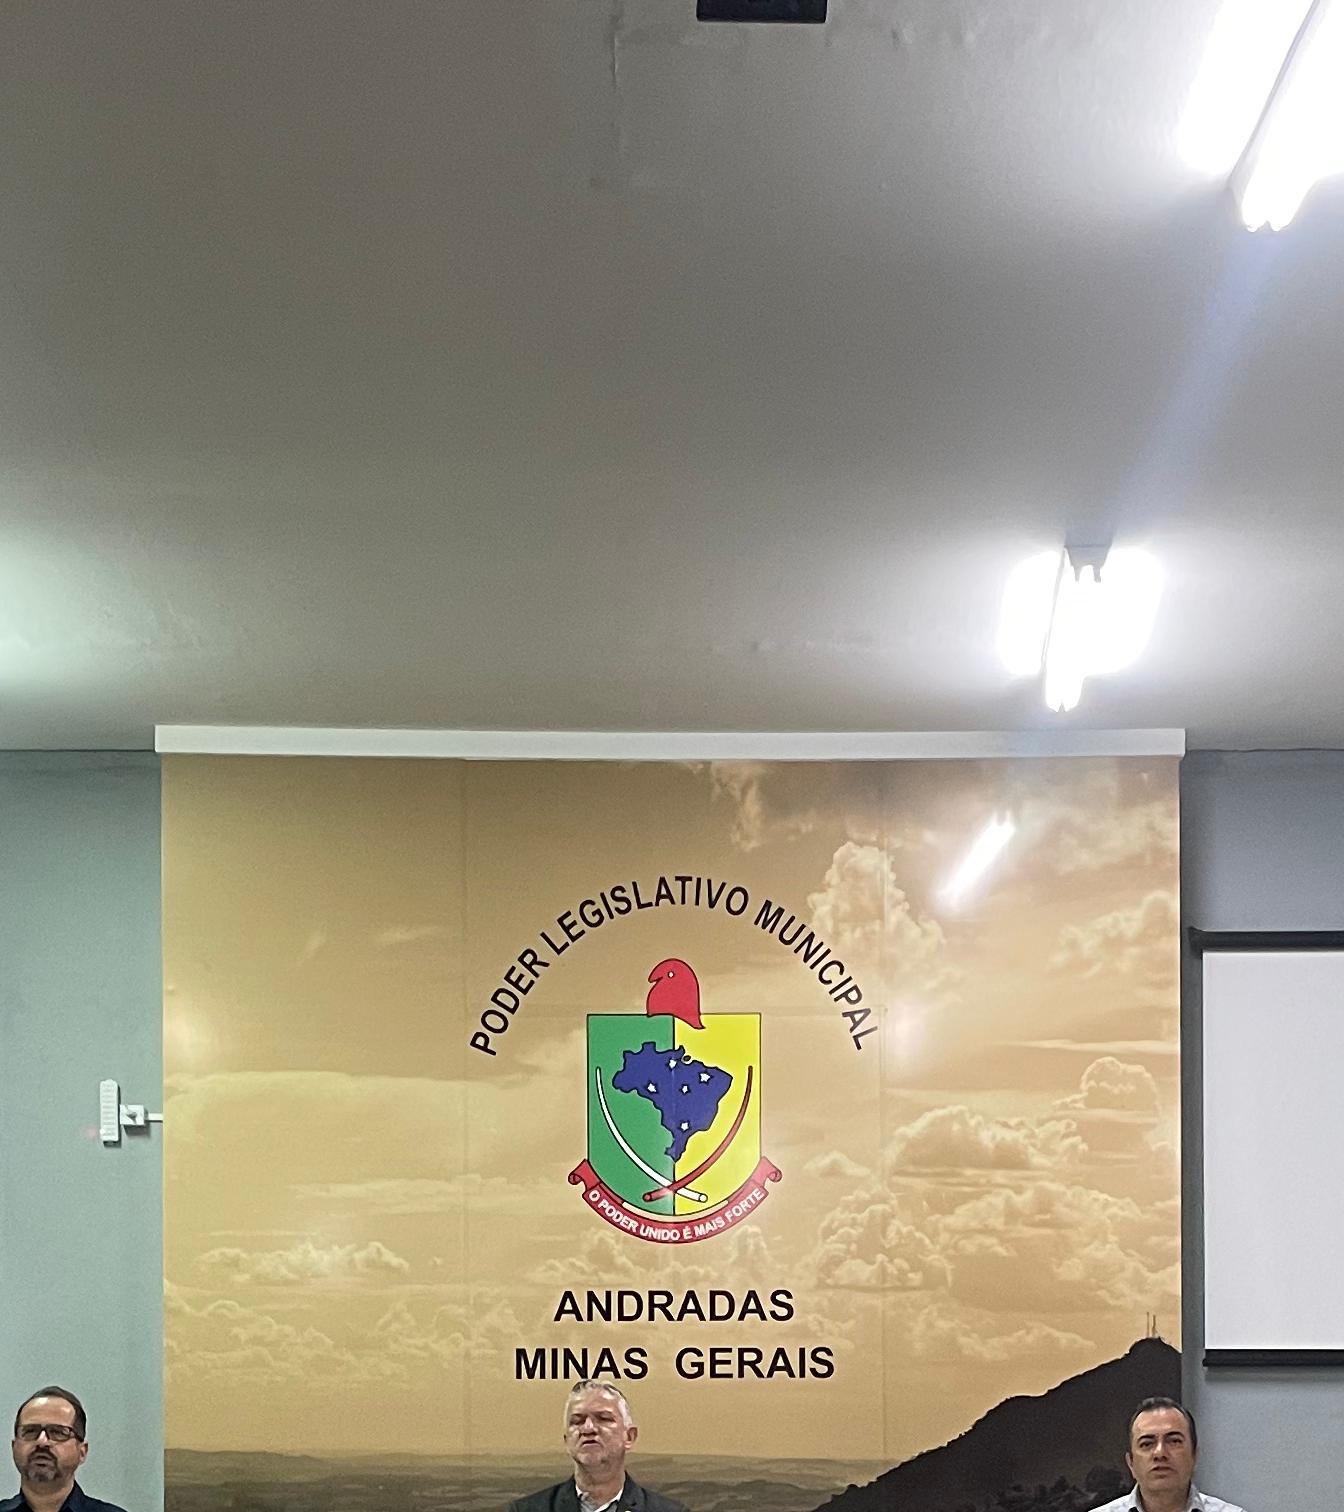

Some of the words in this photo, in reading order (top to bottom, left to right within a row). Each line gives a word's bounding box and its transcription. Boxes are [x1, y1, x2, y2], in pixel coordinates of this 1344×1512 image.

[469, 948, 550, 1056] PODER
[540, 875, 749, 956] LEGISLATIVO
[753, 900, 878, 1051] MUNICIPAL
[588, 1189, 601, 1200] O
[598, 1198, 638, 1233] PODER
[640, 1224, 680, 1241] UNIDO
[683, 1226, 692, 1240] É
[694, 1217, 726, 1237] MAIS
[724, 1187, 765, 1223] FORTE
[554, 1289, 795, 1322] ANDRADAS
[515, 1347, 649, 1380] MINAS
[675, 1347, 835, 1380] GERAIS
